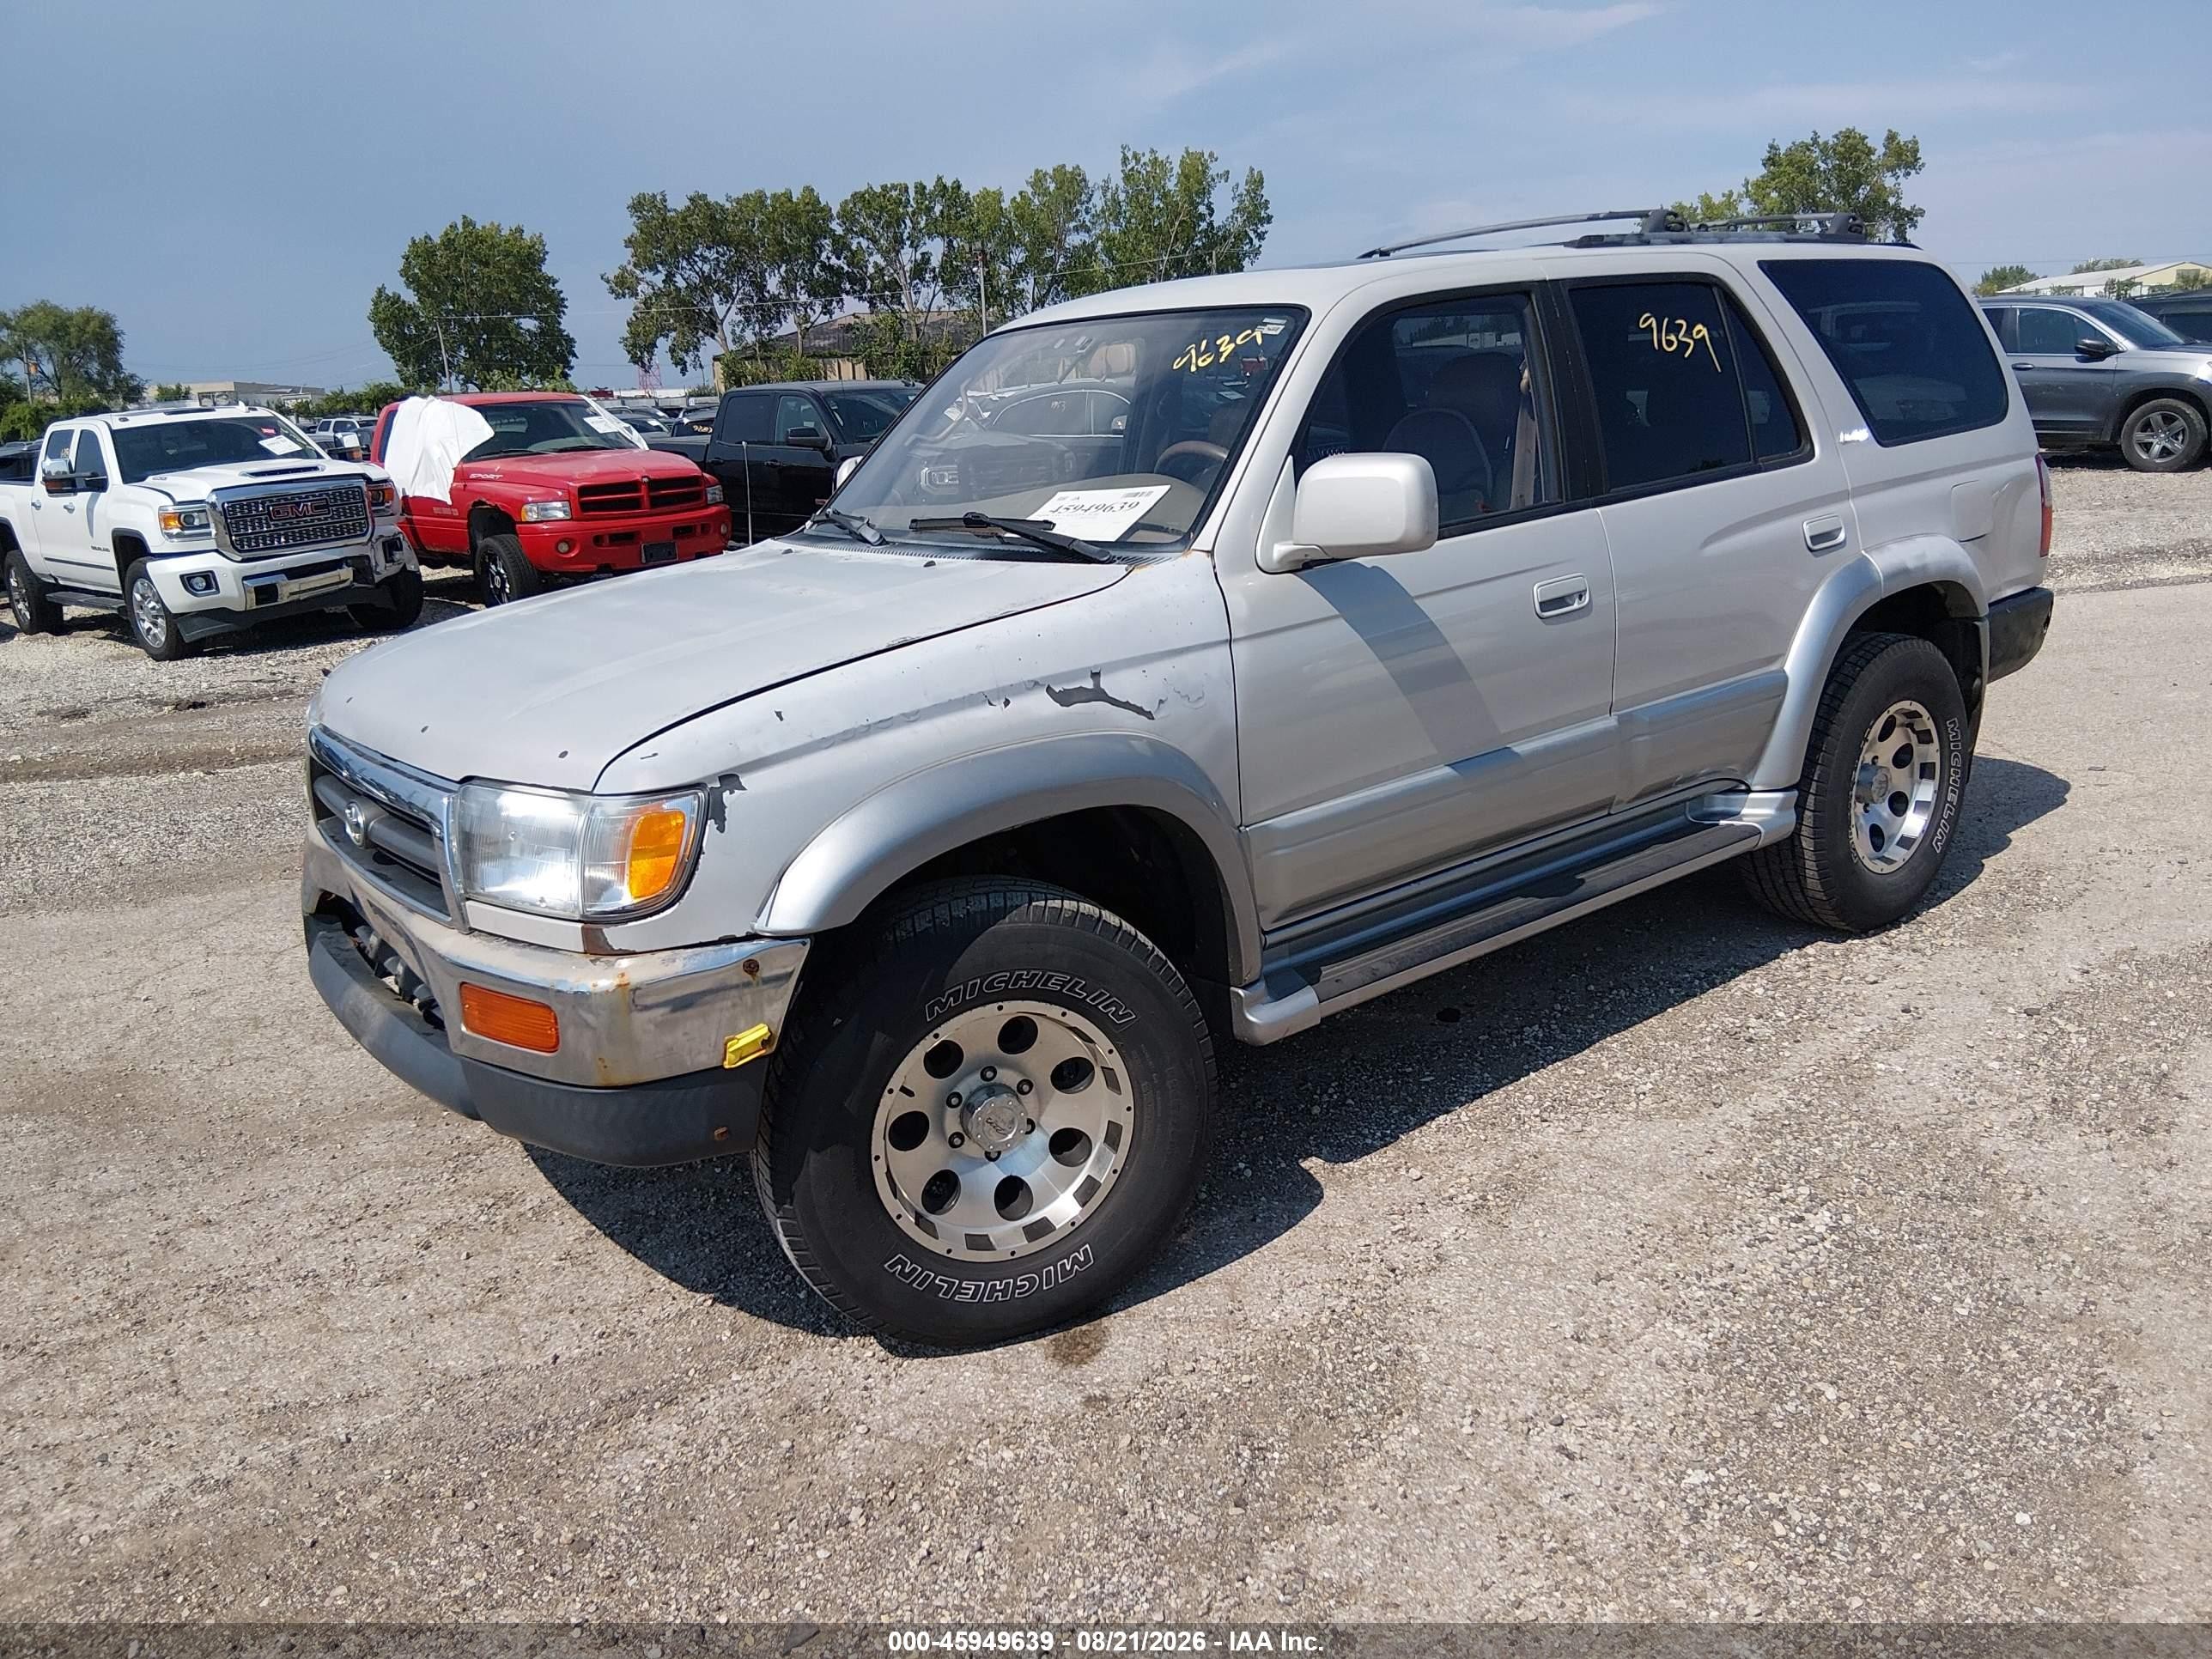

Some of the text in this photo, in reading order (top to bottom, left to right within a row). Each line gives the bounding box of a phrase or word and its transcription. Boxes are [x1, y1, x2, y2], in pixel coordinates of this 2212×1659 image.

[1171, 329, 1263, 373] 9639
[1638, 313, 1723, 374] 9639
[270, 500, 329, 520] GMC
[1048, 501, 1140, 514] 45949639
[1932, 717, 1963, 854] MICHELIN
[925, 969, 1136, 1024] MICHELIN
[884, 1243, 1095, 1304] MICHELIN
